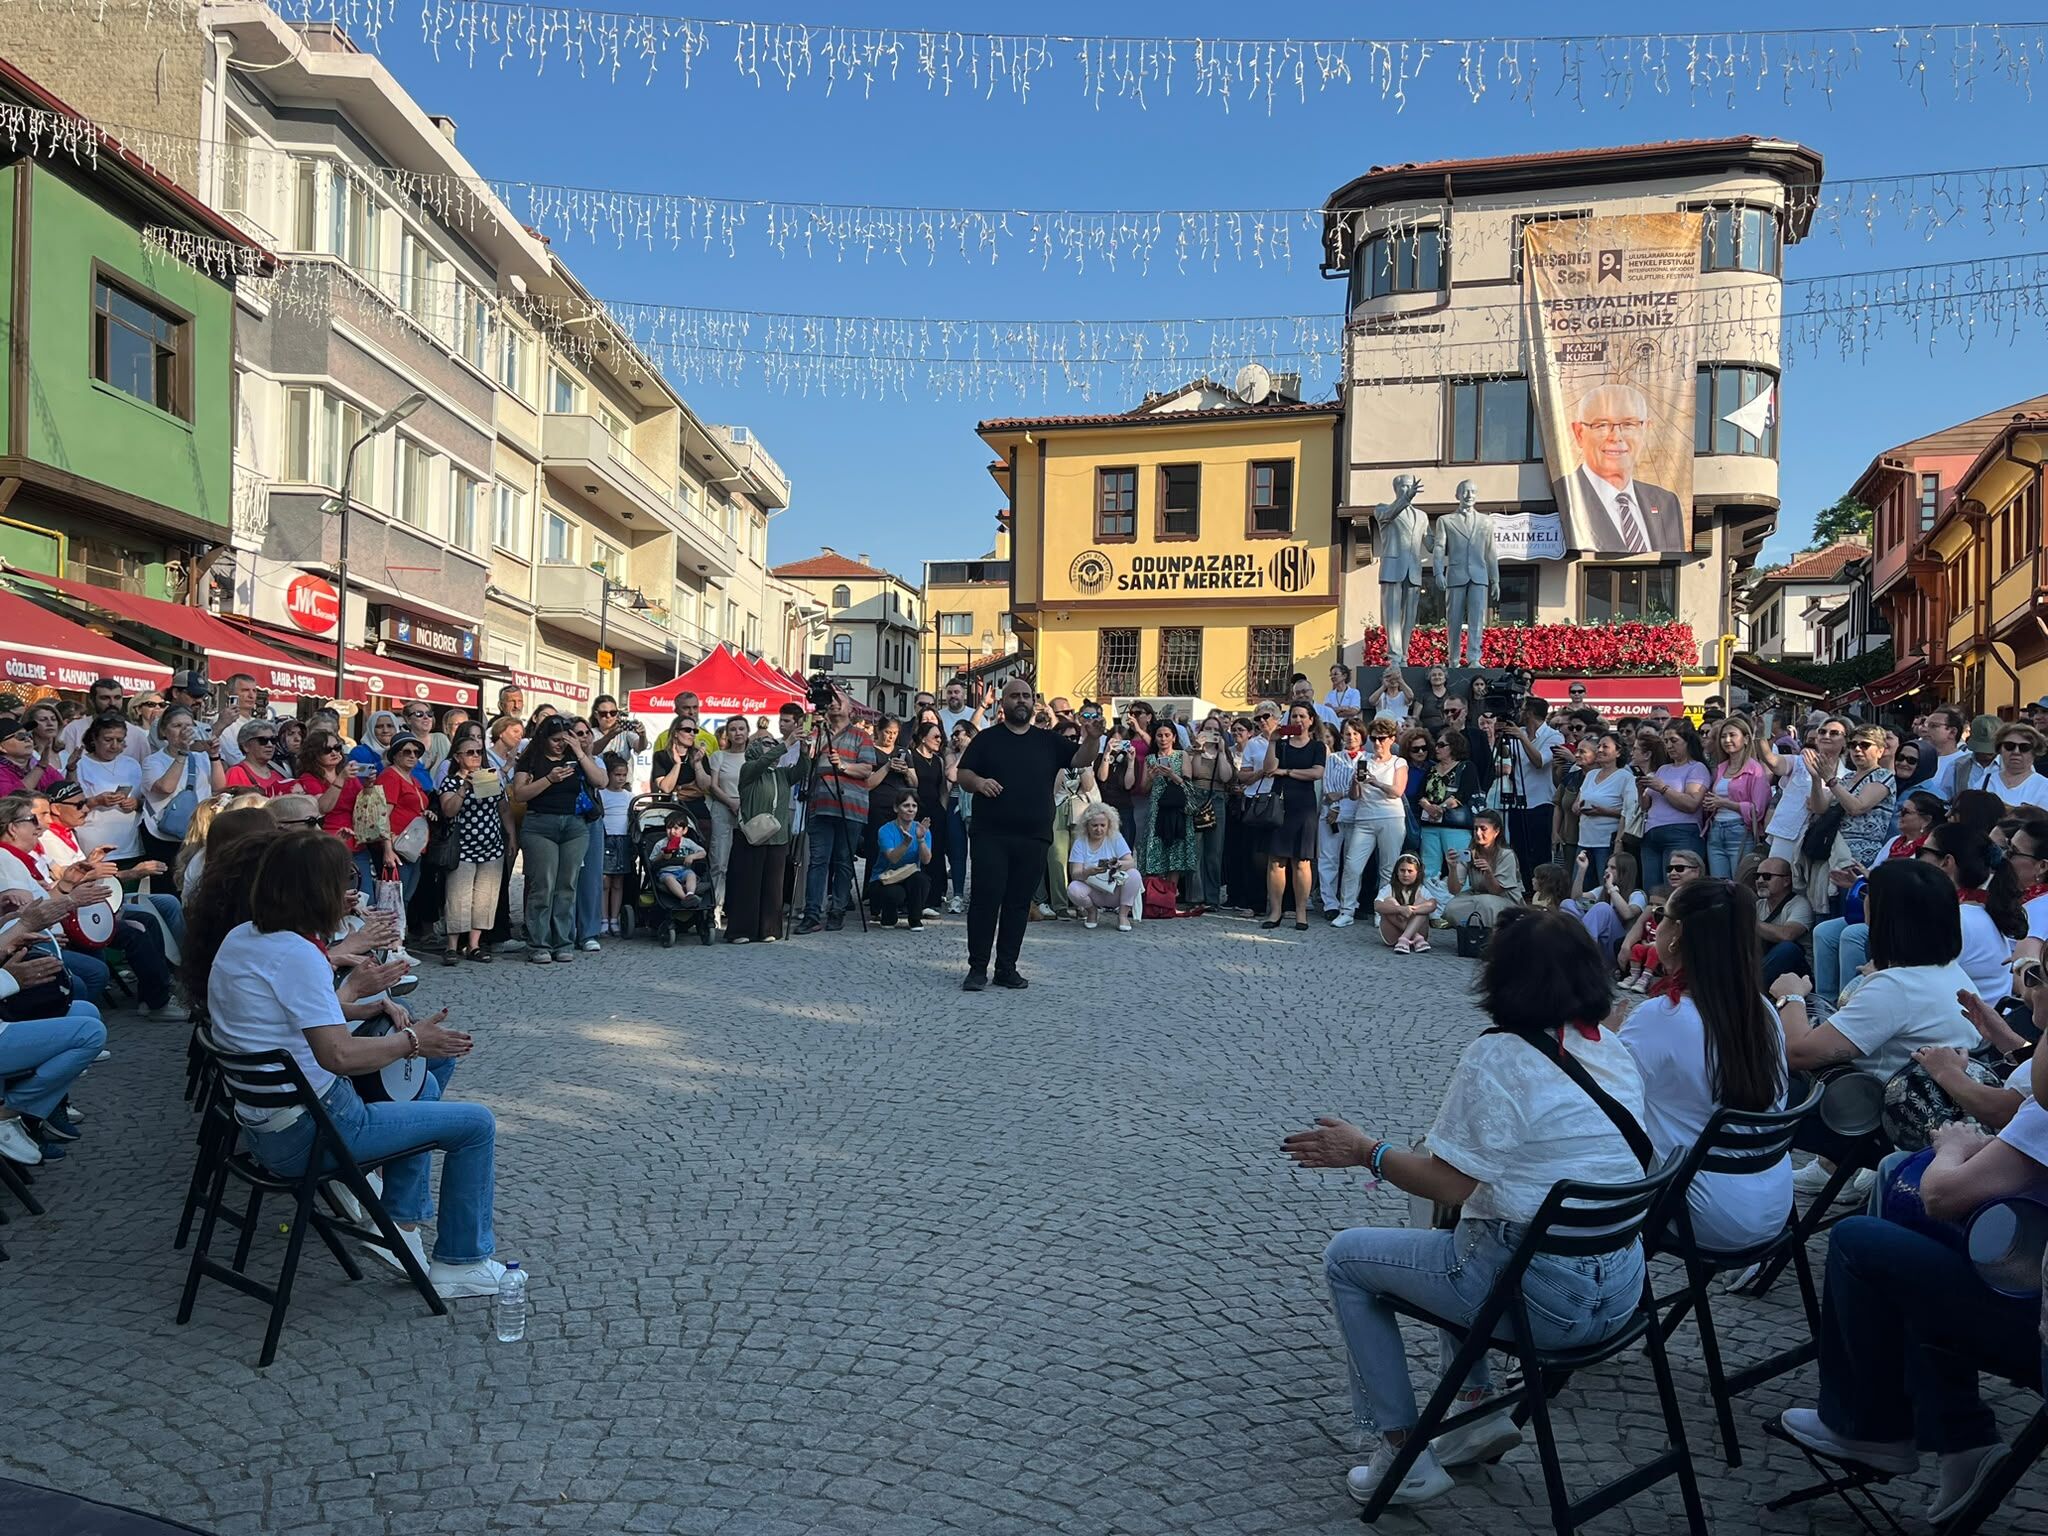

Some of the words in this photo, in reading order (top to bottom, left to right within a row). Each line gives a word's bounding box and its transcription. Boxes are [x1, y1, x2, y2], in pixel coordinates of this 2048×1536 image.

[1601, 253, 1620, 270] 9.
[1628, 259, 1657, 267] HEYKEL
[1588, 310, 1674, 329] GELDİNİZ
[1566, 343, 1602, 352] KAZIM
[1566, 352, 1595, 361] KURT
[1132, 554, 1254, 573] ODUNPAZARI
[1117, 574, 1180, 591] SANAT
[1183, 566, 1264, 589] MERKEZİ
[5, 658, 47, 680] GÖZLEME
[742, 697, 767, 712] Güzel
